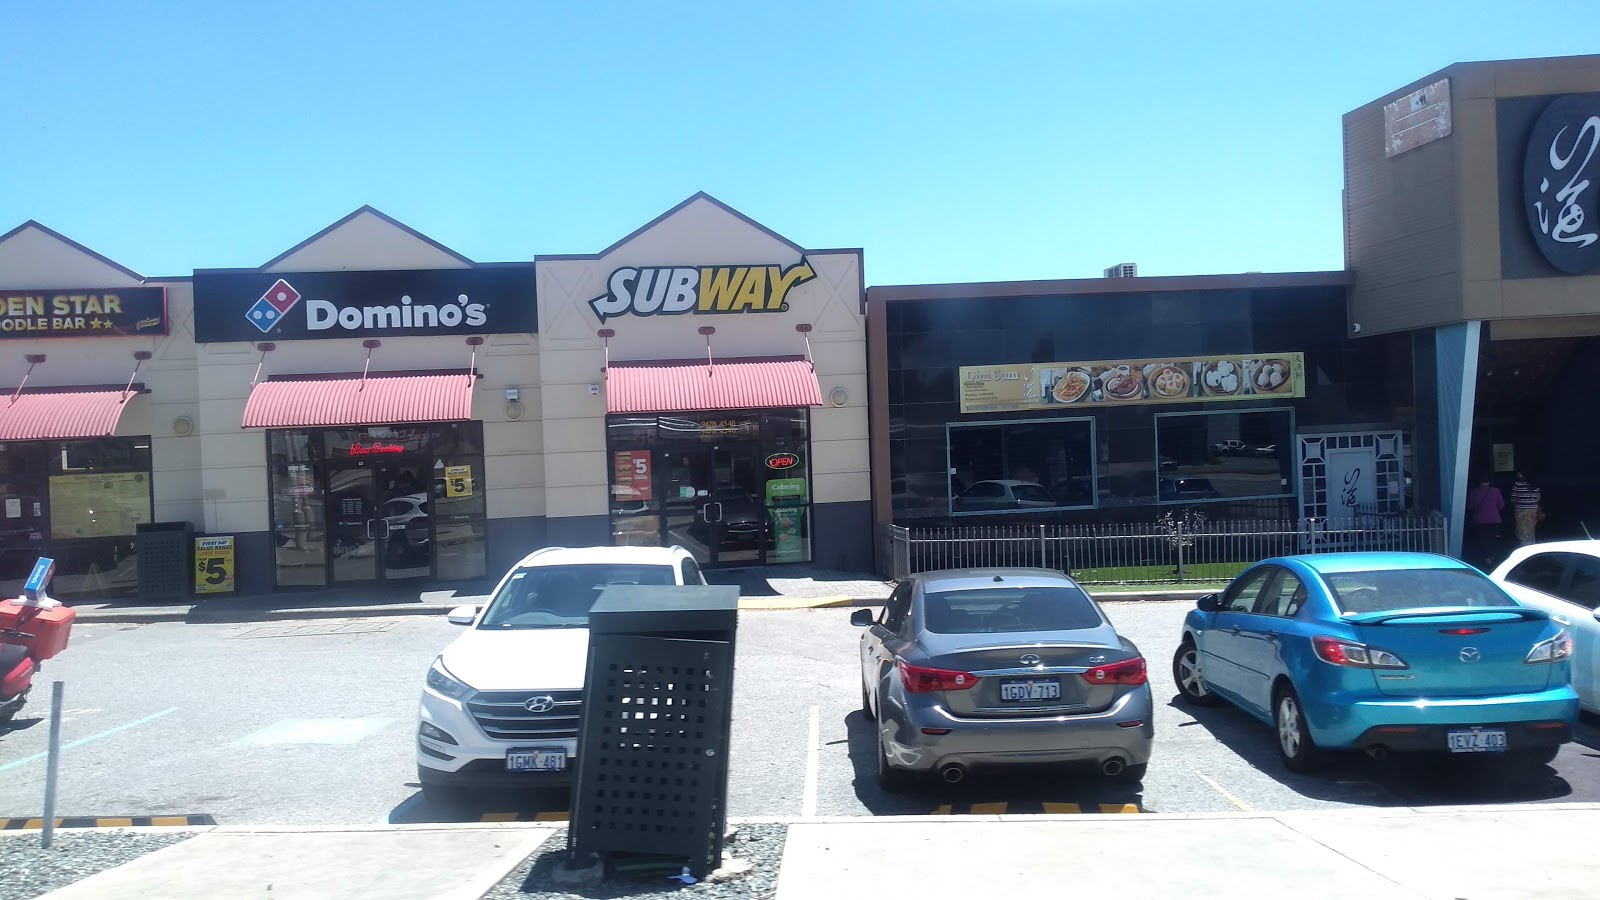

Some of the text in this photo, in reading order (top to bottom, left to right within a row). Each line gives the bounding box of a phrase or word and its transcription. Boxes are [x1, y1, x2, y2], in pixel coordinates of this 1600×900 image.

[590, 260, 816, 322] SUBWAY
[52, 294, 122, 315] STAR
[306, 294, 487, 331] Domino's
[0, 317, 86, 331] ODLE BAR
[769, 457, 793, 467] OPEN
